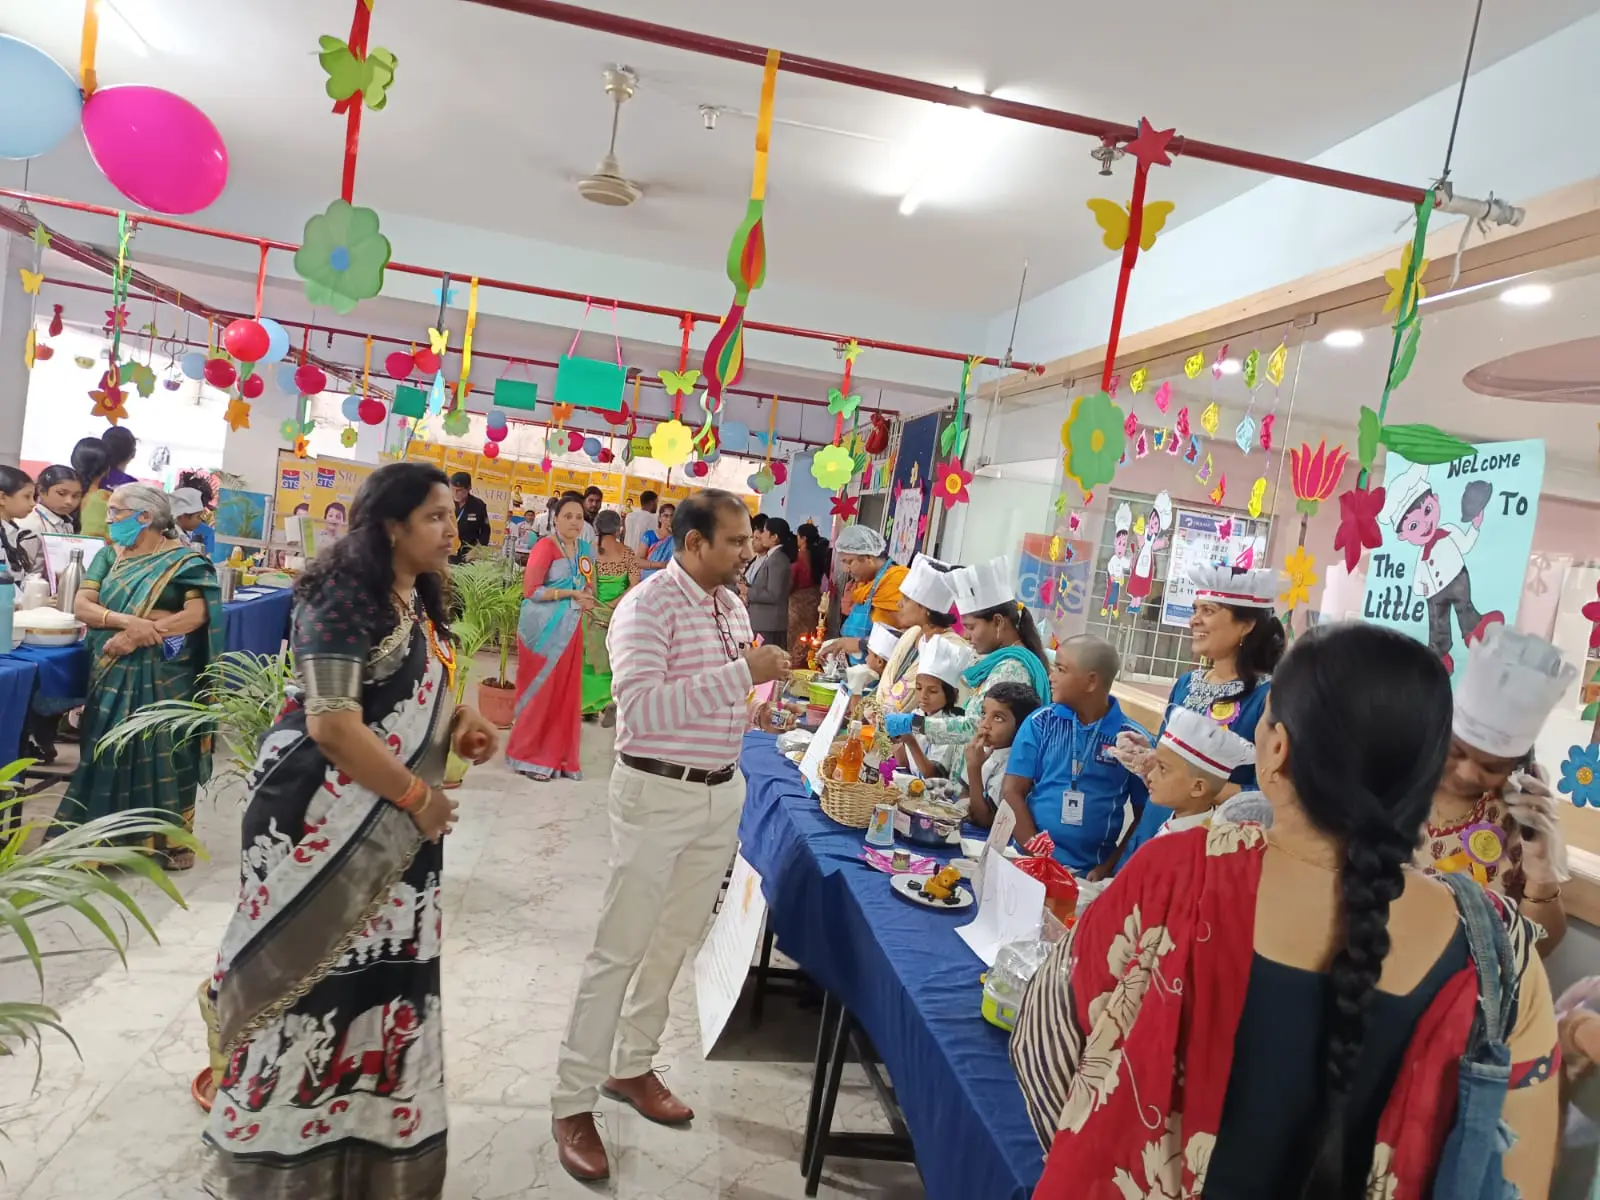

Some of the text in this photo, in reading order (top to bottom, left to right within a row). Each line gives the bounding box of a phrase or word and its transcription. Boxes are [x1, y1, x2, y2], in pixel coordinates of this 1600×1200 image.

[282, 480, 300, 489] GTS
[316, 478, 335, 488] GTS
[1499, 491, 1528, 516] To
[1373, 554, 1405, 579] The
[1364, 586, 1425, 622] Little
